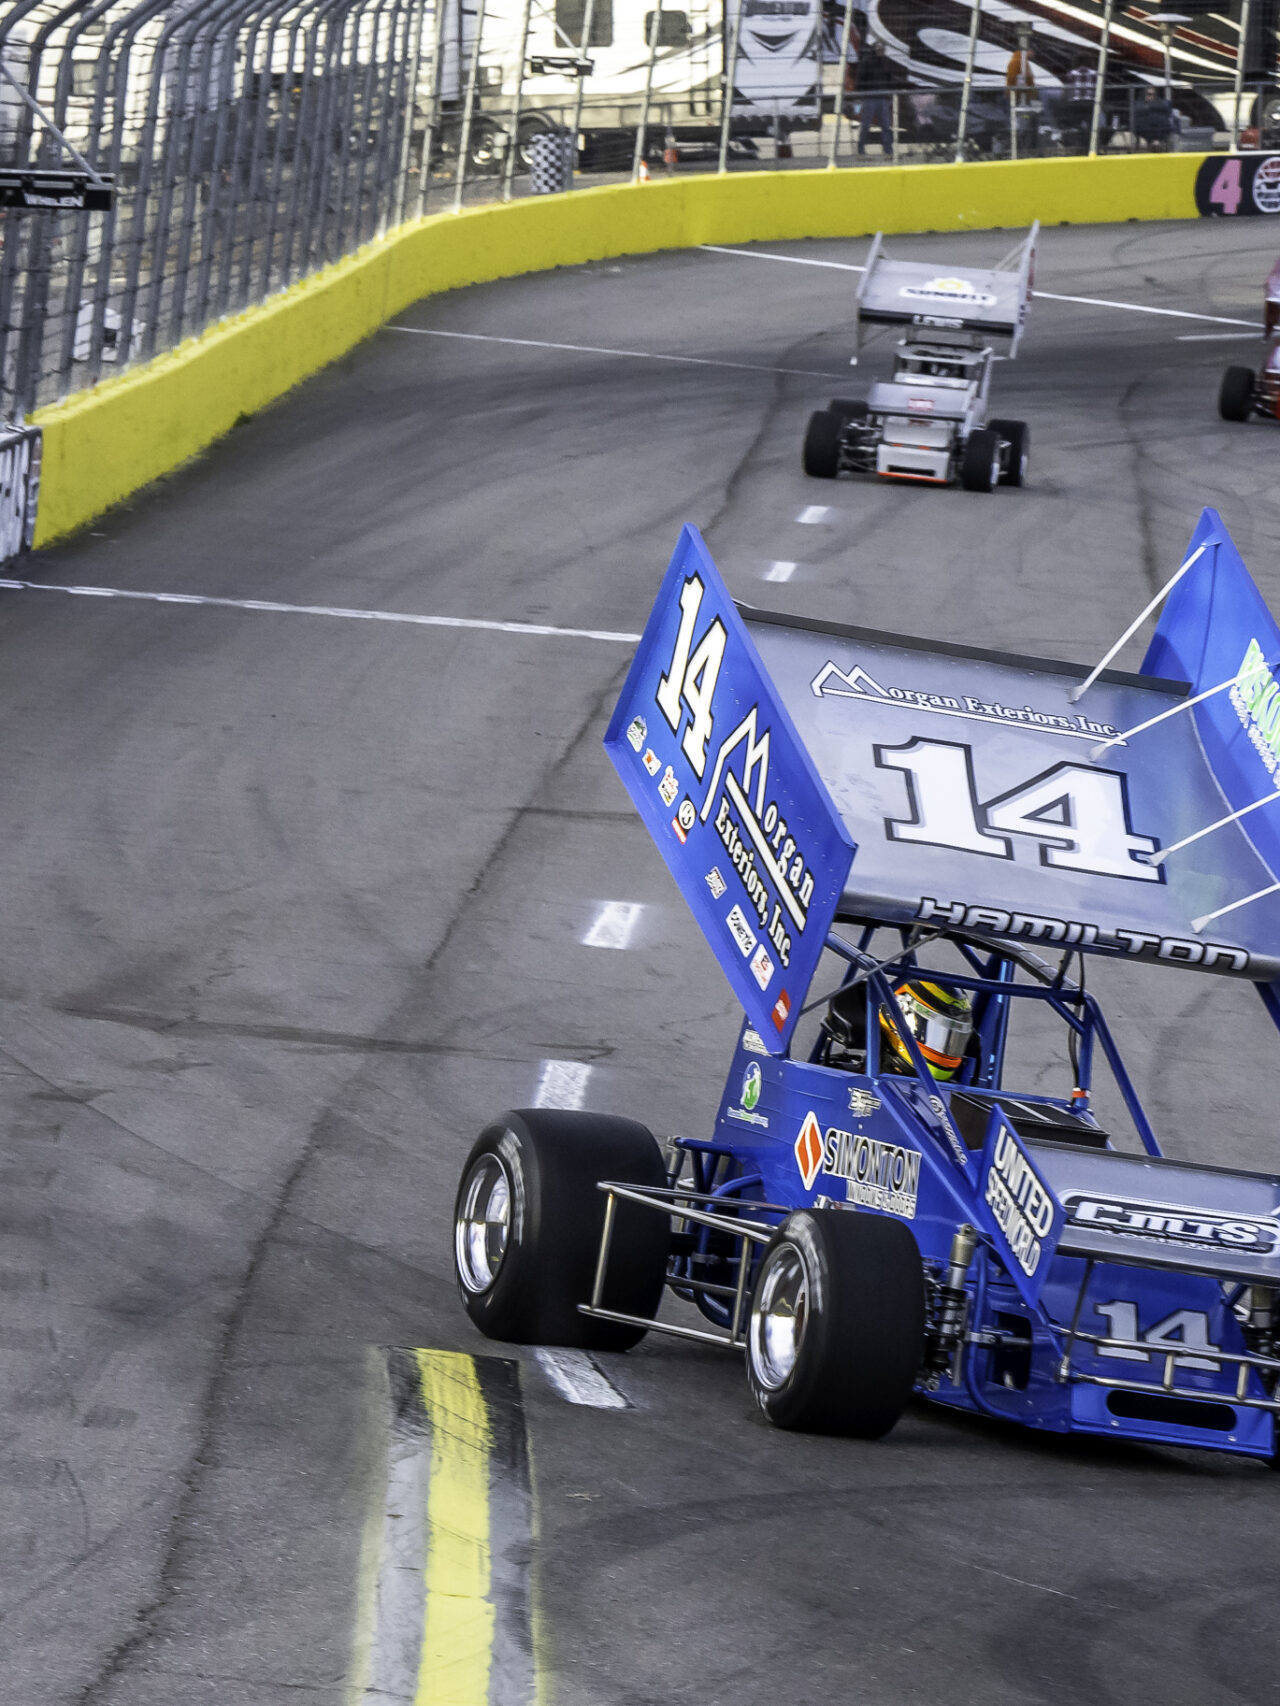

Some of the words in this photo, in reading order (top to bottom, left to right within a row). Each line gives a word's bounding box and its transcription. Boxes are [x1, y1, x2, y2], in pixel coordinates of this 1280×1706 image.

[1209, 158, 1243, 215] 4
[656, 571, 728, 783] 14
[809, 659, 960, 709] Morgan
[964, 694, 1077, 732] Exteriors,
[700, 703, 816, 909] Morgan
[872, 735, 1167, 885] 14
[914, 896, 1250, 972] HAMILTON
[823, 1128, 922, 1198] SIMONTON
[993, 1123, 1055, 1239] UNITED
[1094, 1299, 1222, 1372] 14
